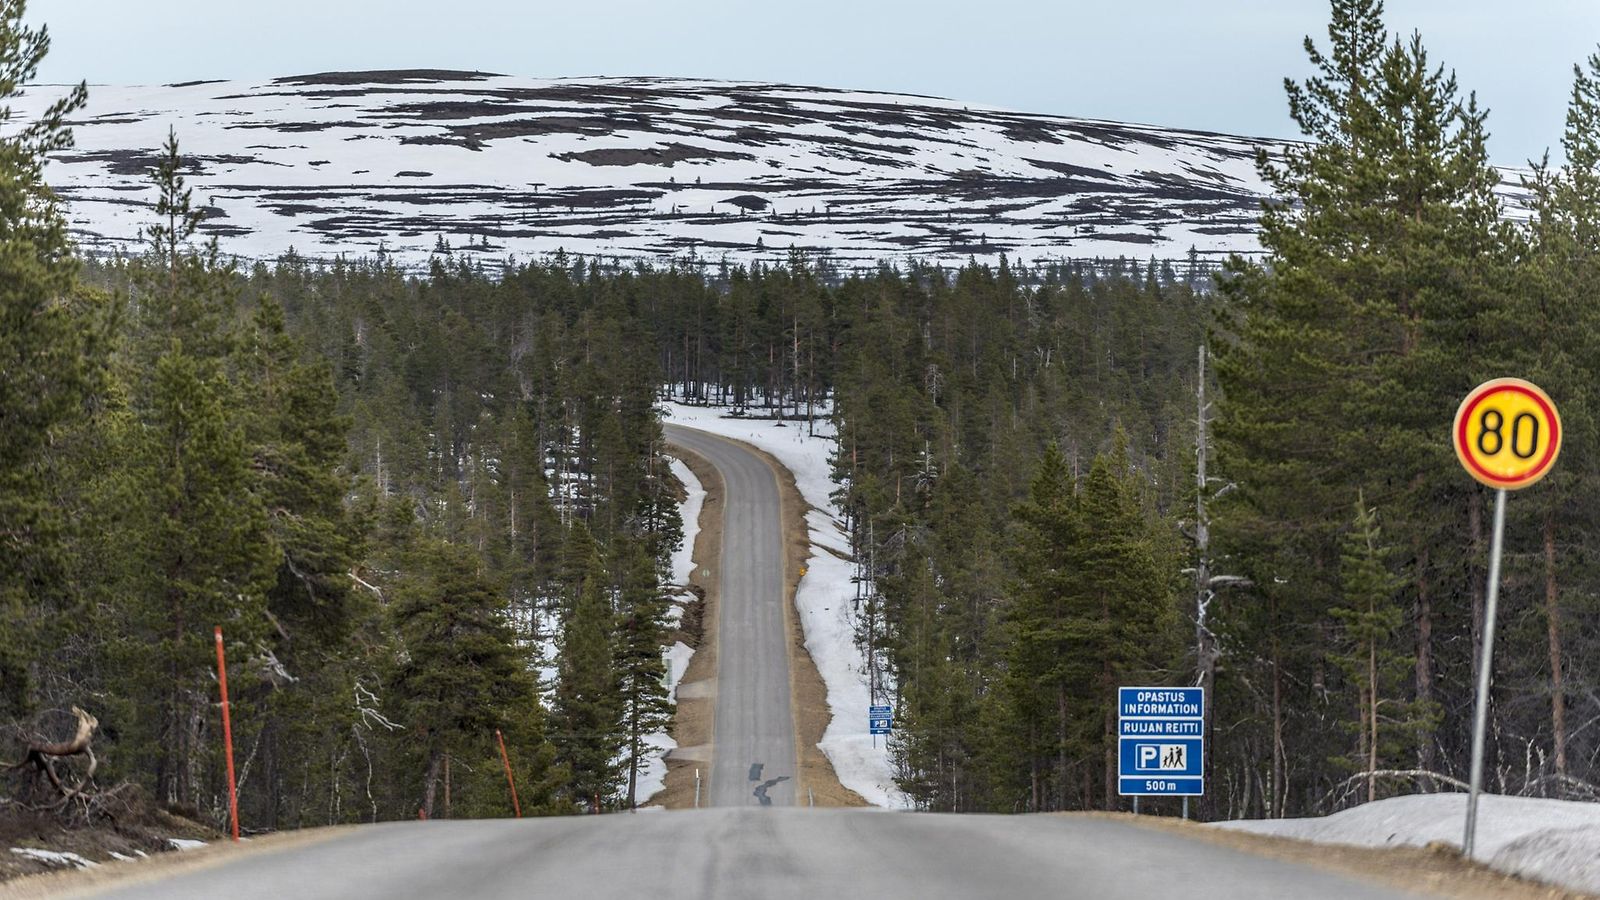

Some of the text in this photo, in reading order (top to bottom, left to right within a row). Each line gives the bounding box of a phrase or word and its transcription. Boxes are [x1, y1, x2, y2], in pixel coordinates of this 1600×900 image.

[1478, 410, 1539, 458] 80
[1137, 692, 1185, 702] OPASTUS
[1125, 704, 1198, 714] INFORMATION
[1124, 722, 1198, 733] RUIJAN REITTI
[1140, 746, 1157, 768] P
[1146, 781, 1176, 791] 500 m
